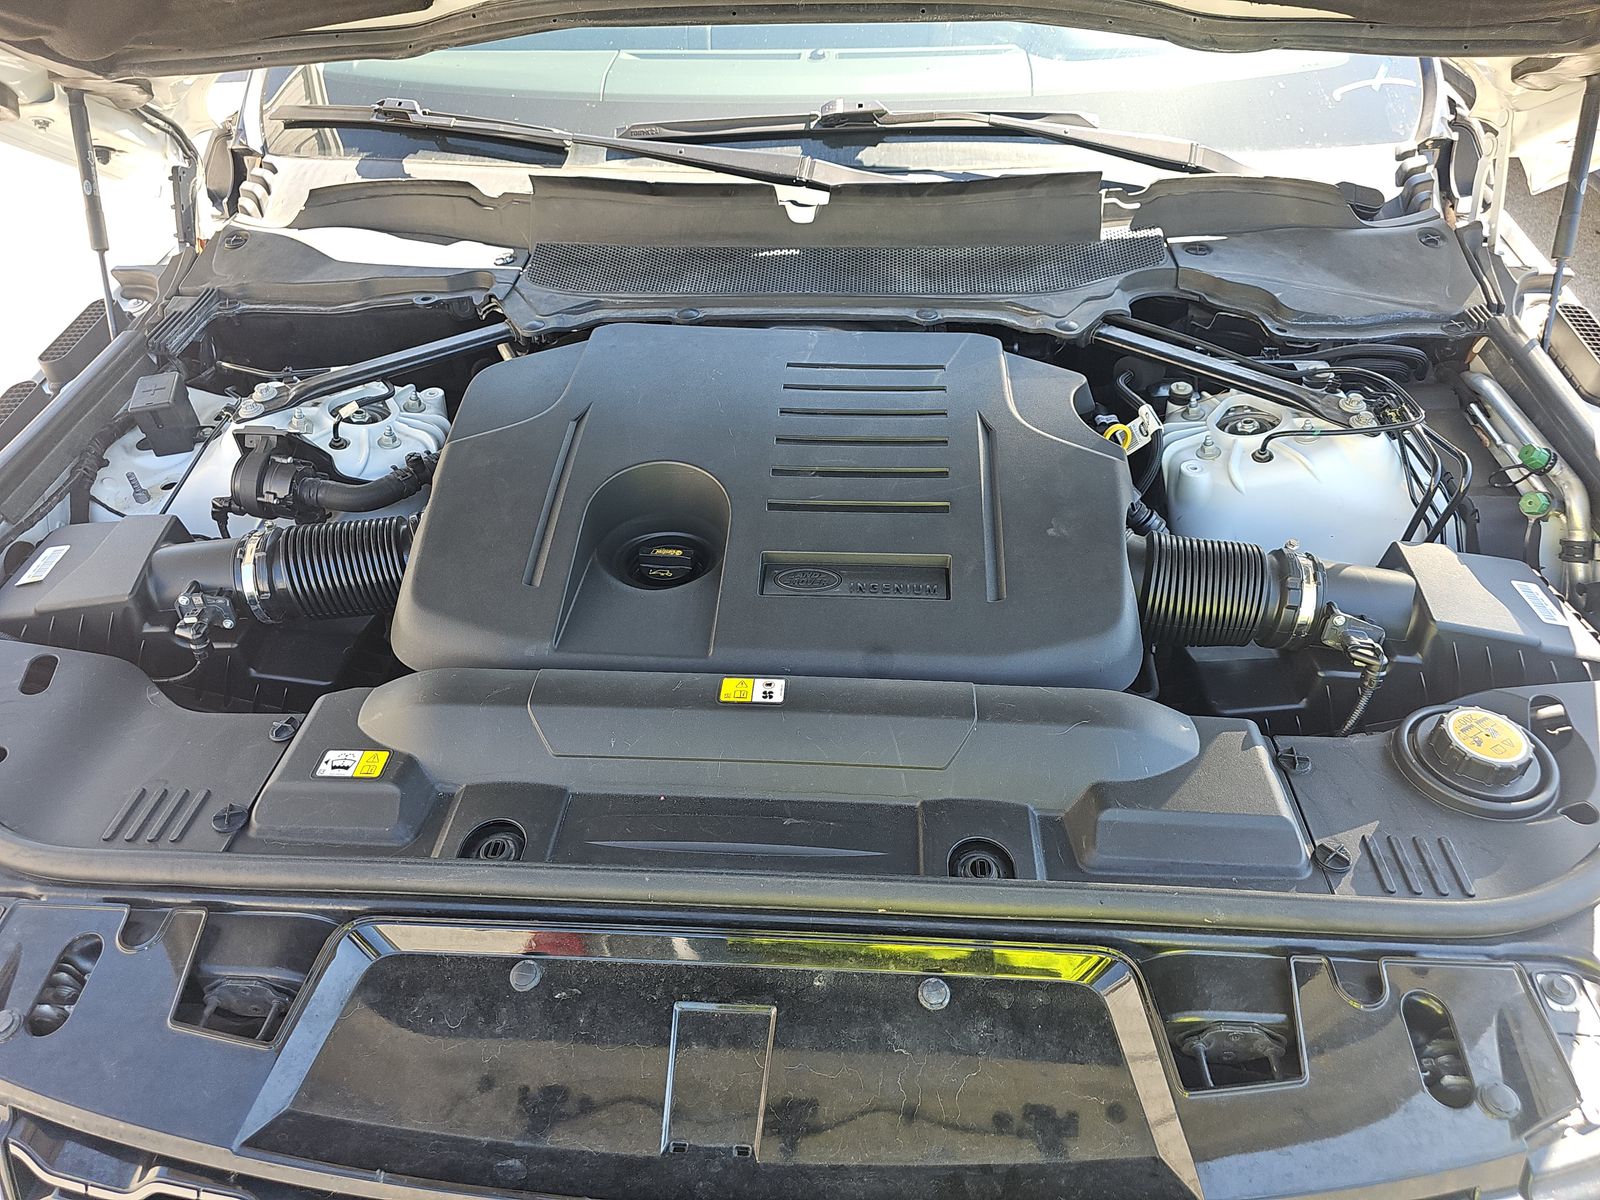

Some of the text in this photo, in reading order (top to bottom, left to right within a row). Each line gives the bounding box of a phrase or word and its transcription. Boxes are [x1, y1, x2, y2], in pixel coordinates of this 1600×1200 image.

[788, 571, 821, 579] LAND
[790, 578, 828, 586] ROVER
[850, 582, 938, 595] INGENIUM
